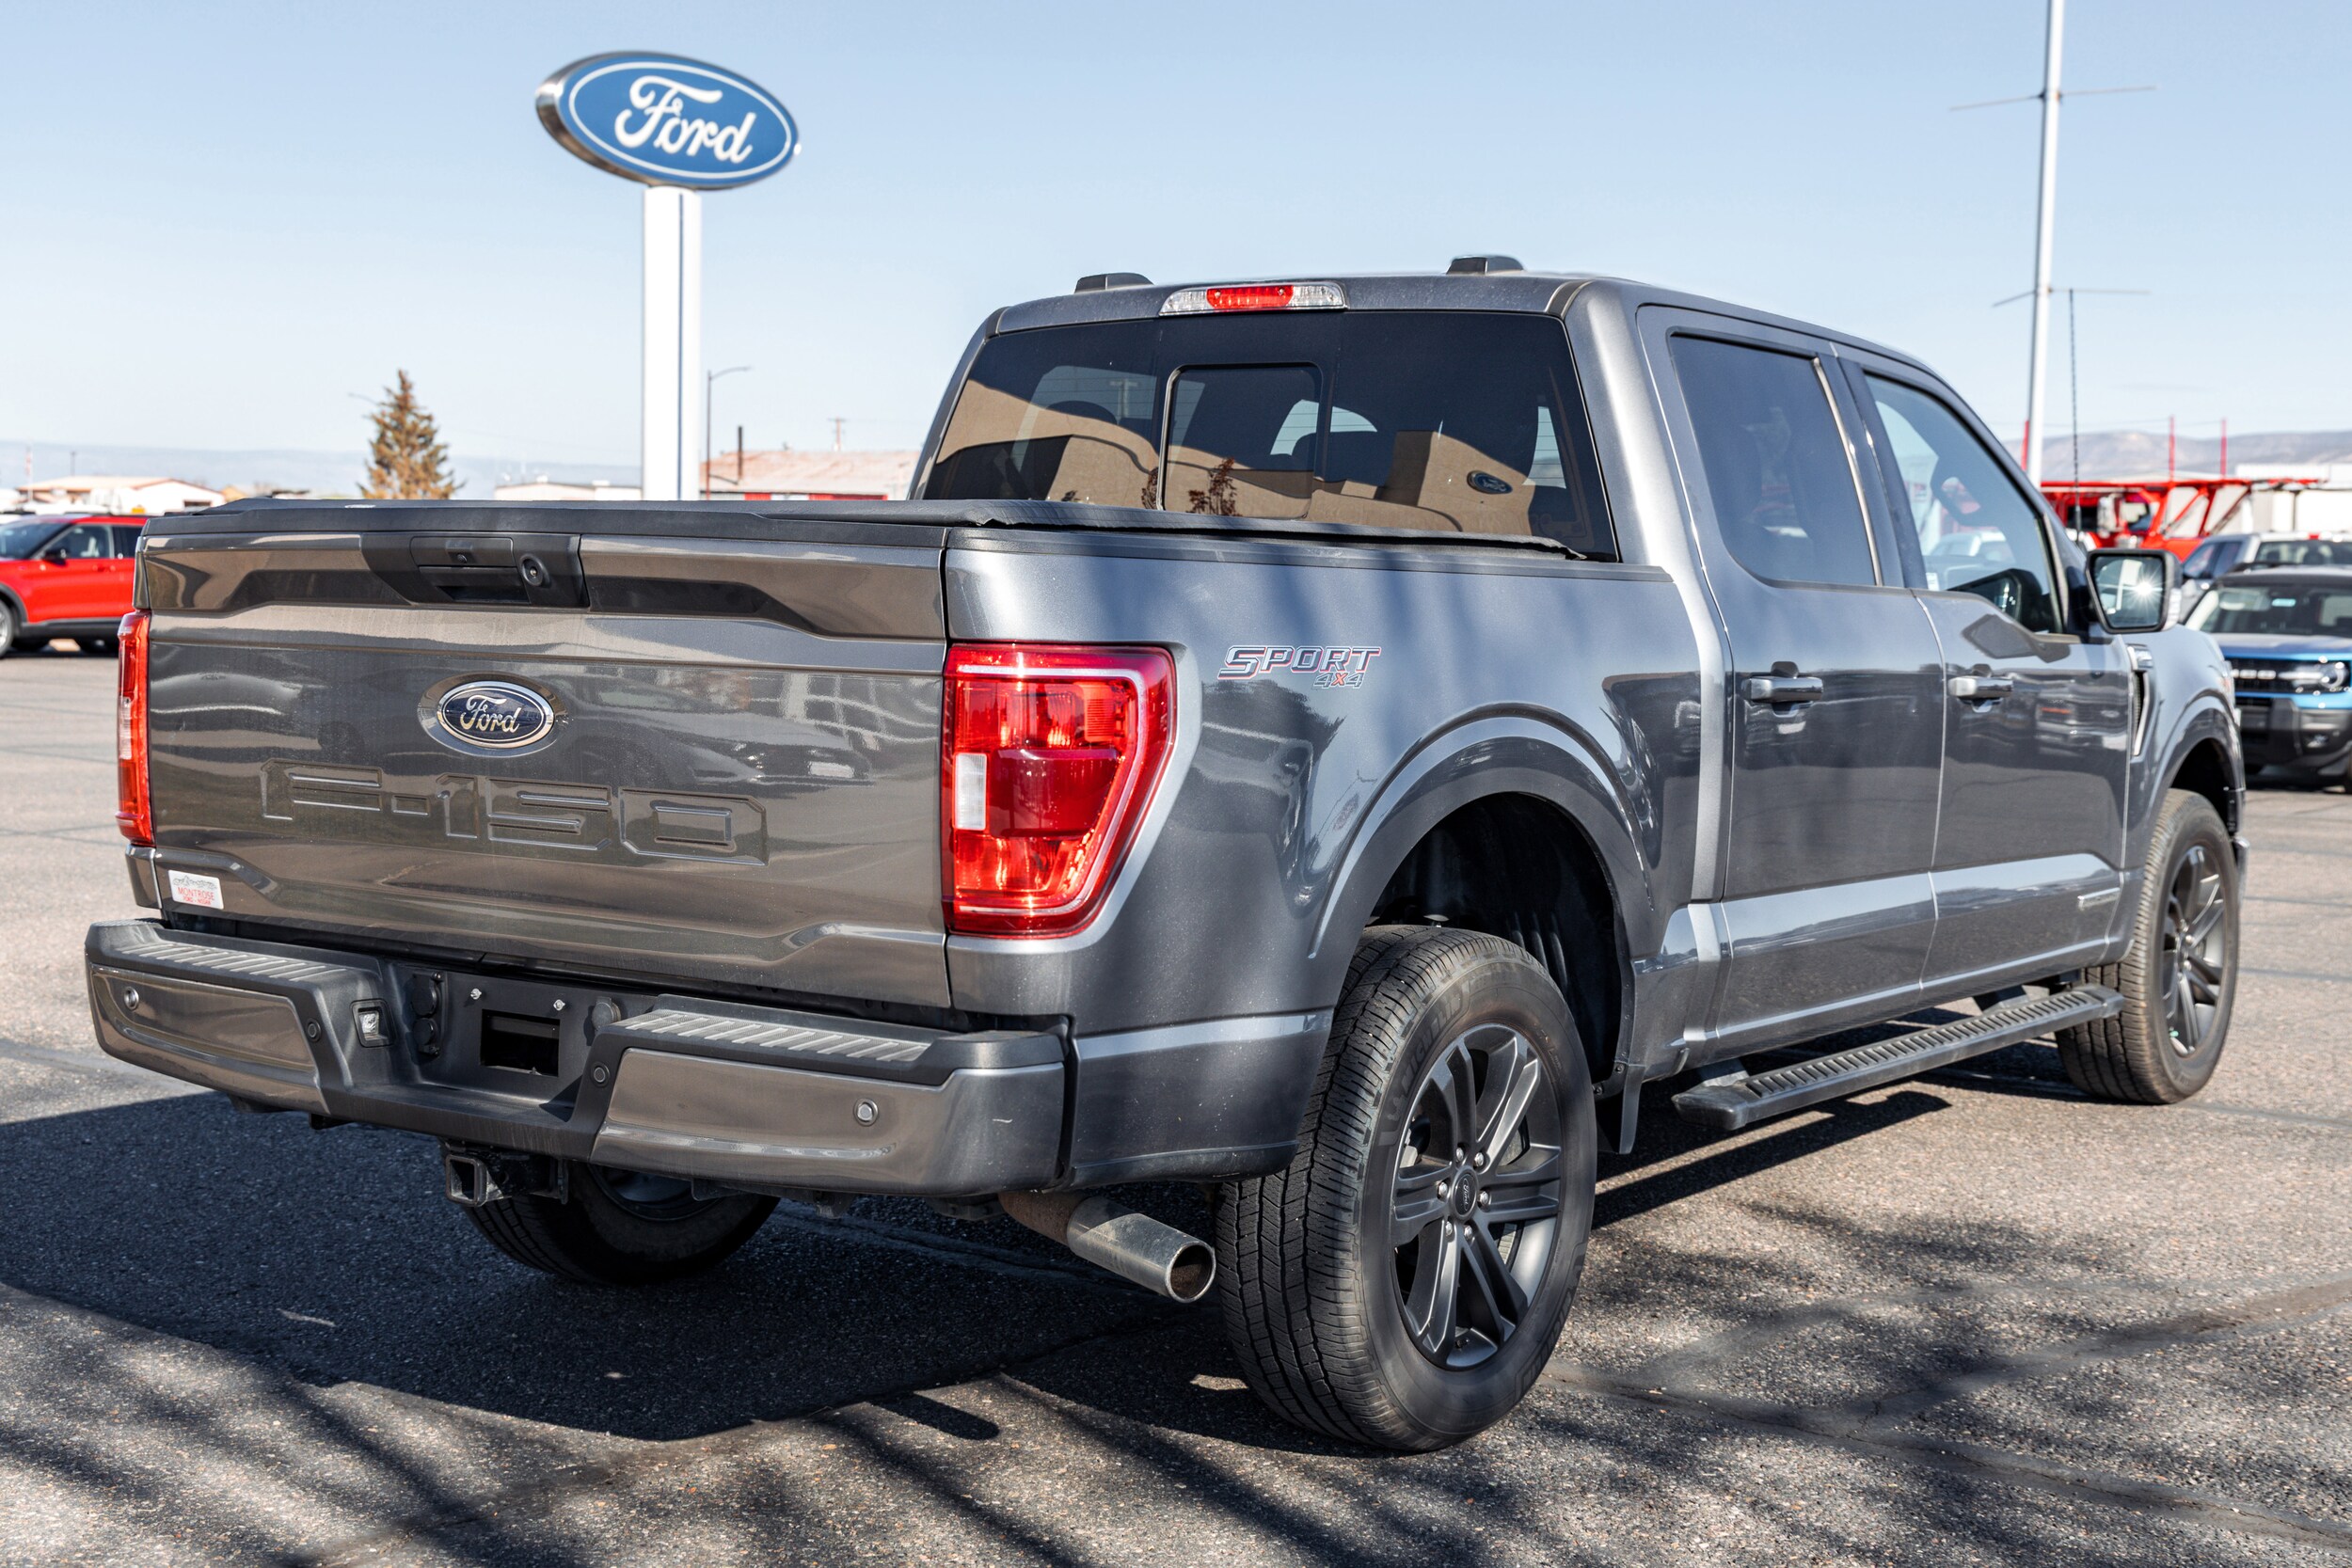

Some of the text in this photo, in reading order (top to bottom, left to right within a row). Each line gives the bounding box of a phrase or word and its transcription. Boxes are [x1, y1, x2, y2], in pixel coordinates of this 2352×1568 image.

[614, 74, 756, 164] Ford
[1216, 644, 1382, 680] SPORT
[459, 694, 522, 734] Ford
[261, 758, 770, 867] F-150
